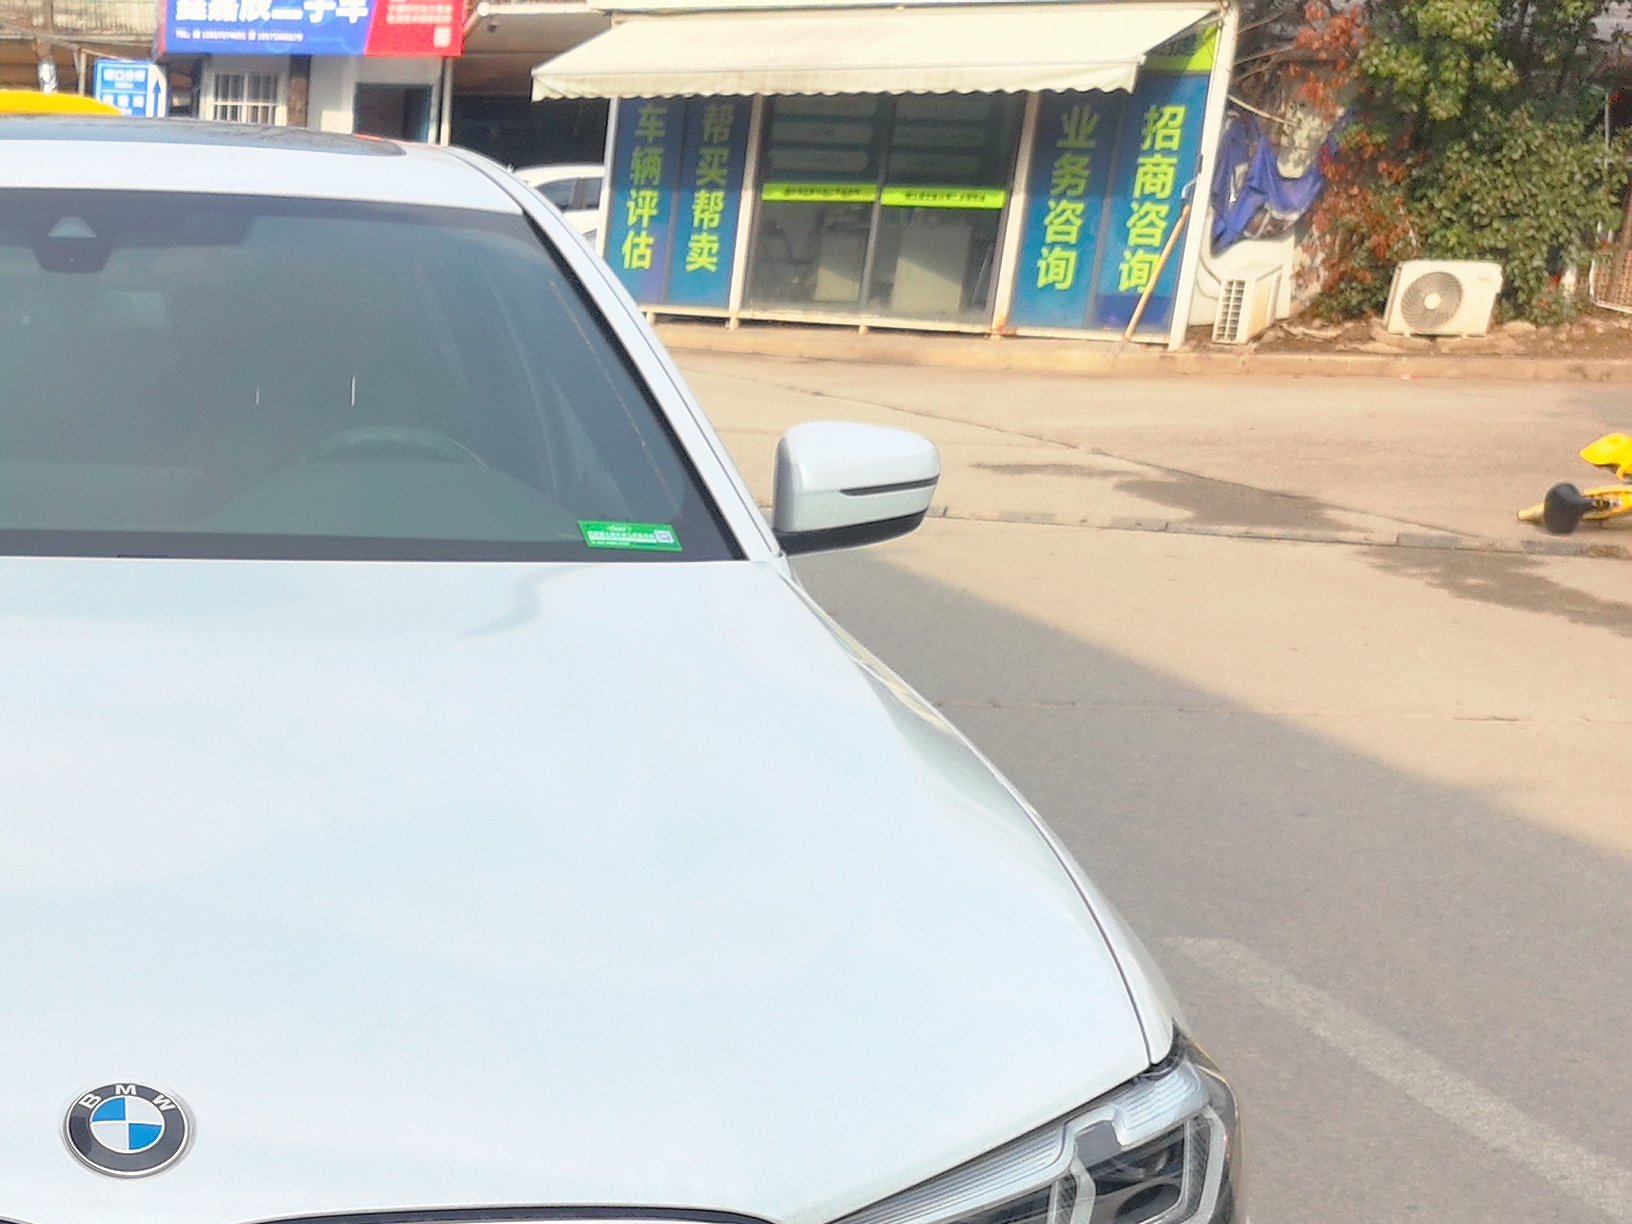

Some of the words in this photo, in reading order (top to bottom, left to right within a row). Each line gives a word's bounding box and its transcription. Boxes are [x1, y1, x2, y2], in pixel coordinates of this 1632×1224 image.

[621, 103, 667, 270] 车辆评估
[685, 103, 734, 273] 帮买帮卖
[1036, 105, 1100, 291] 业务咨询
[1118, 105, 1186, 293] 招商咨询
[79, 1084, 176, 1111] BMW
